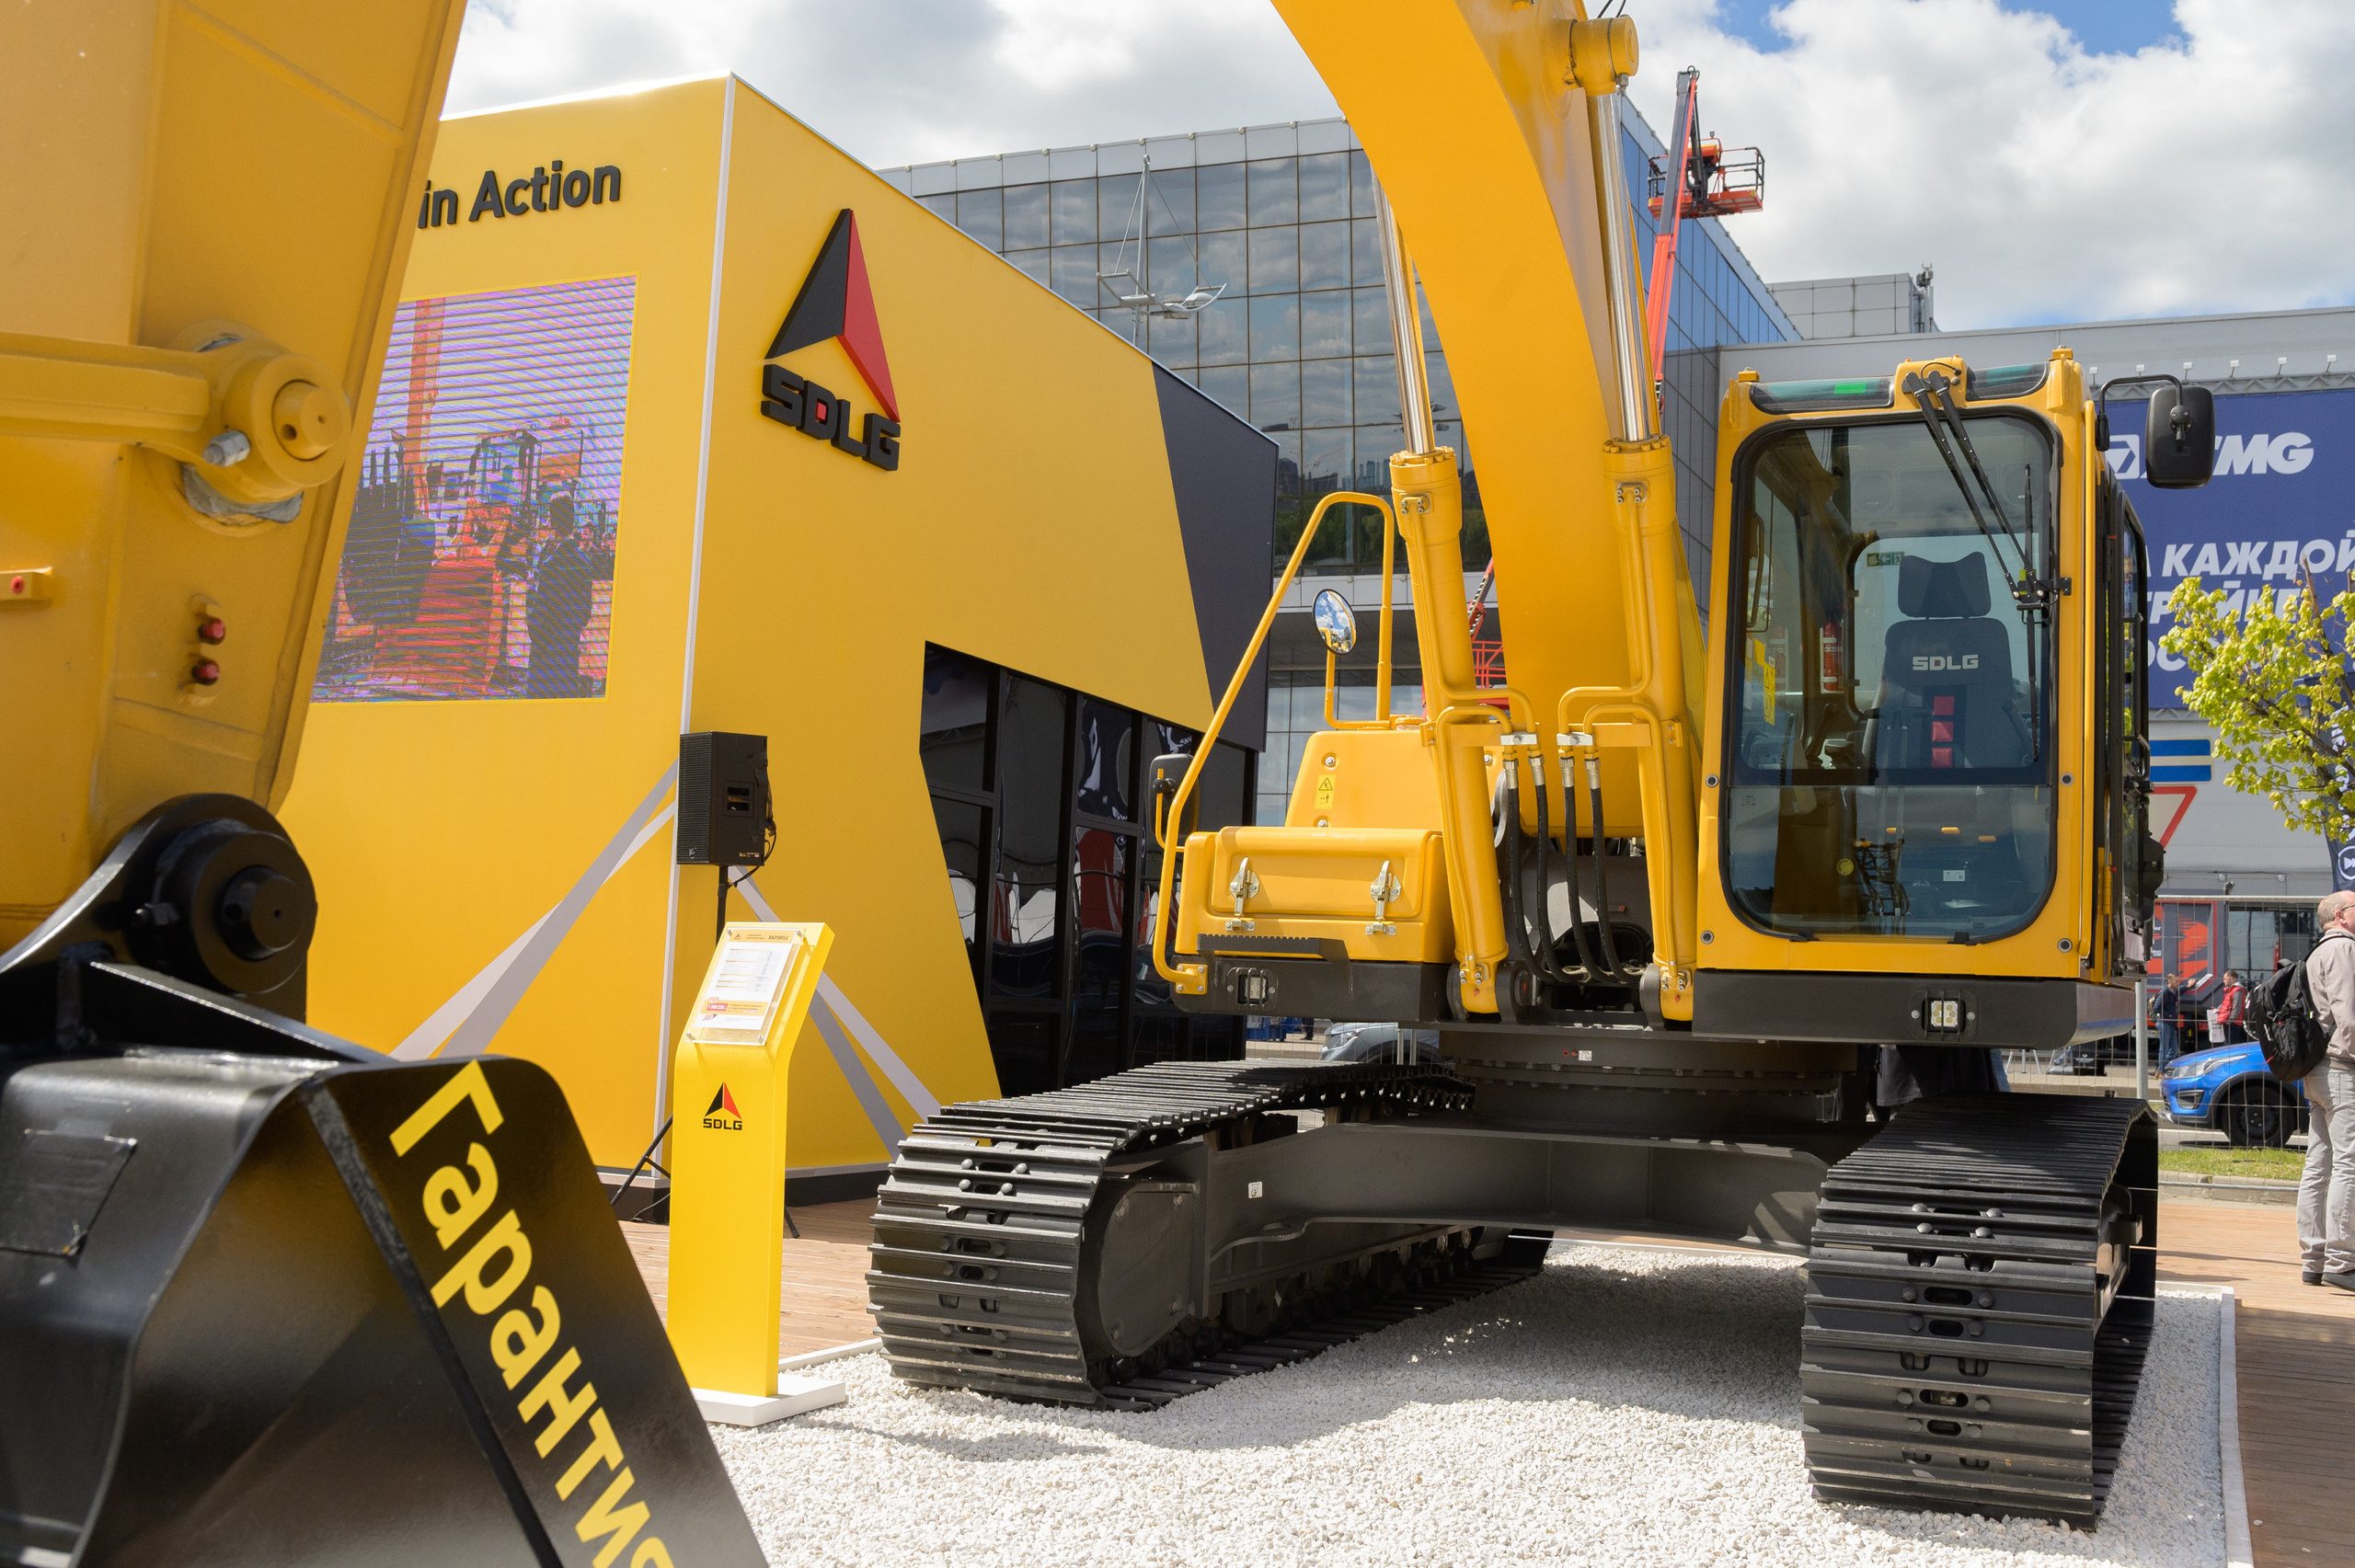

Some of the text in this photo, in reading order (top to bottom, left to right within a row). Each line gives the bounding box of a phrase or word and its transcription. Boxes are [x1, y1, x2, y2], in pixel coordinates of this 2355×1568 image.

[418, 159, 621, 230] in Action
[760, 363, 901, 472] SDLG
[1913, 654, 1979, 670] SDLG
[703, 1118, 742, 1131] SDLG
